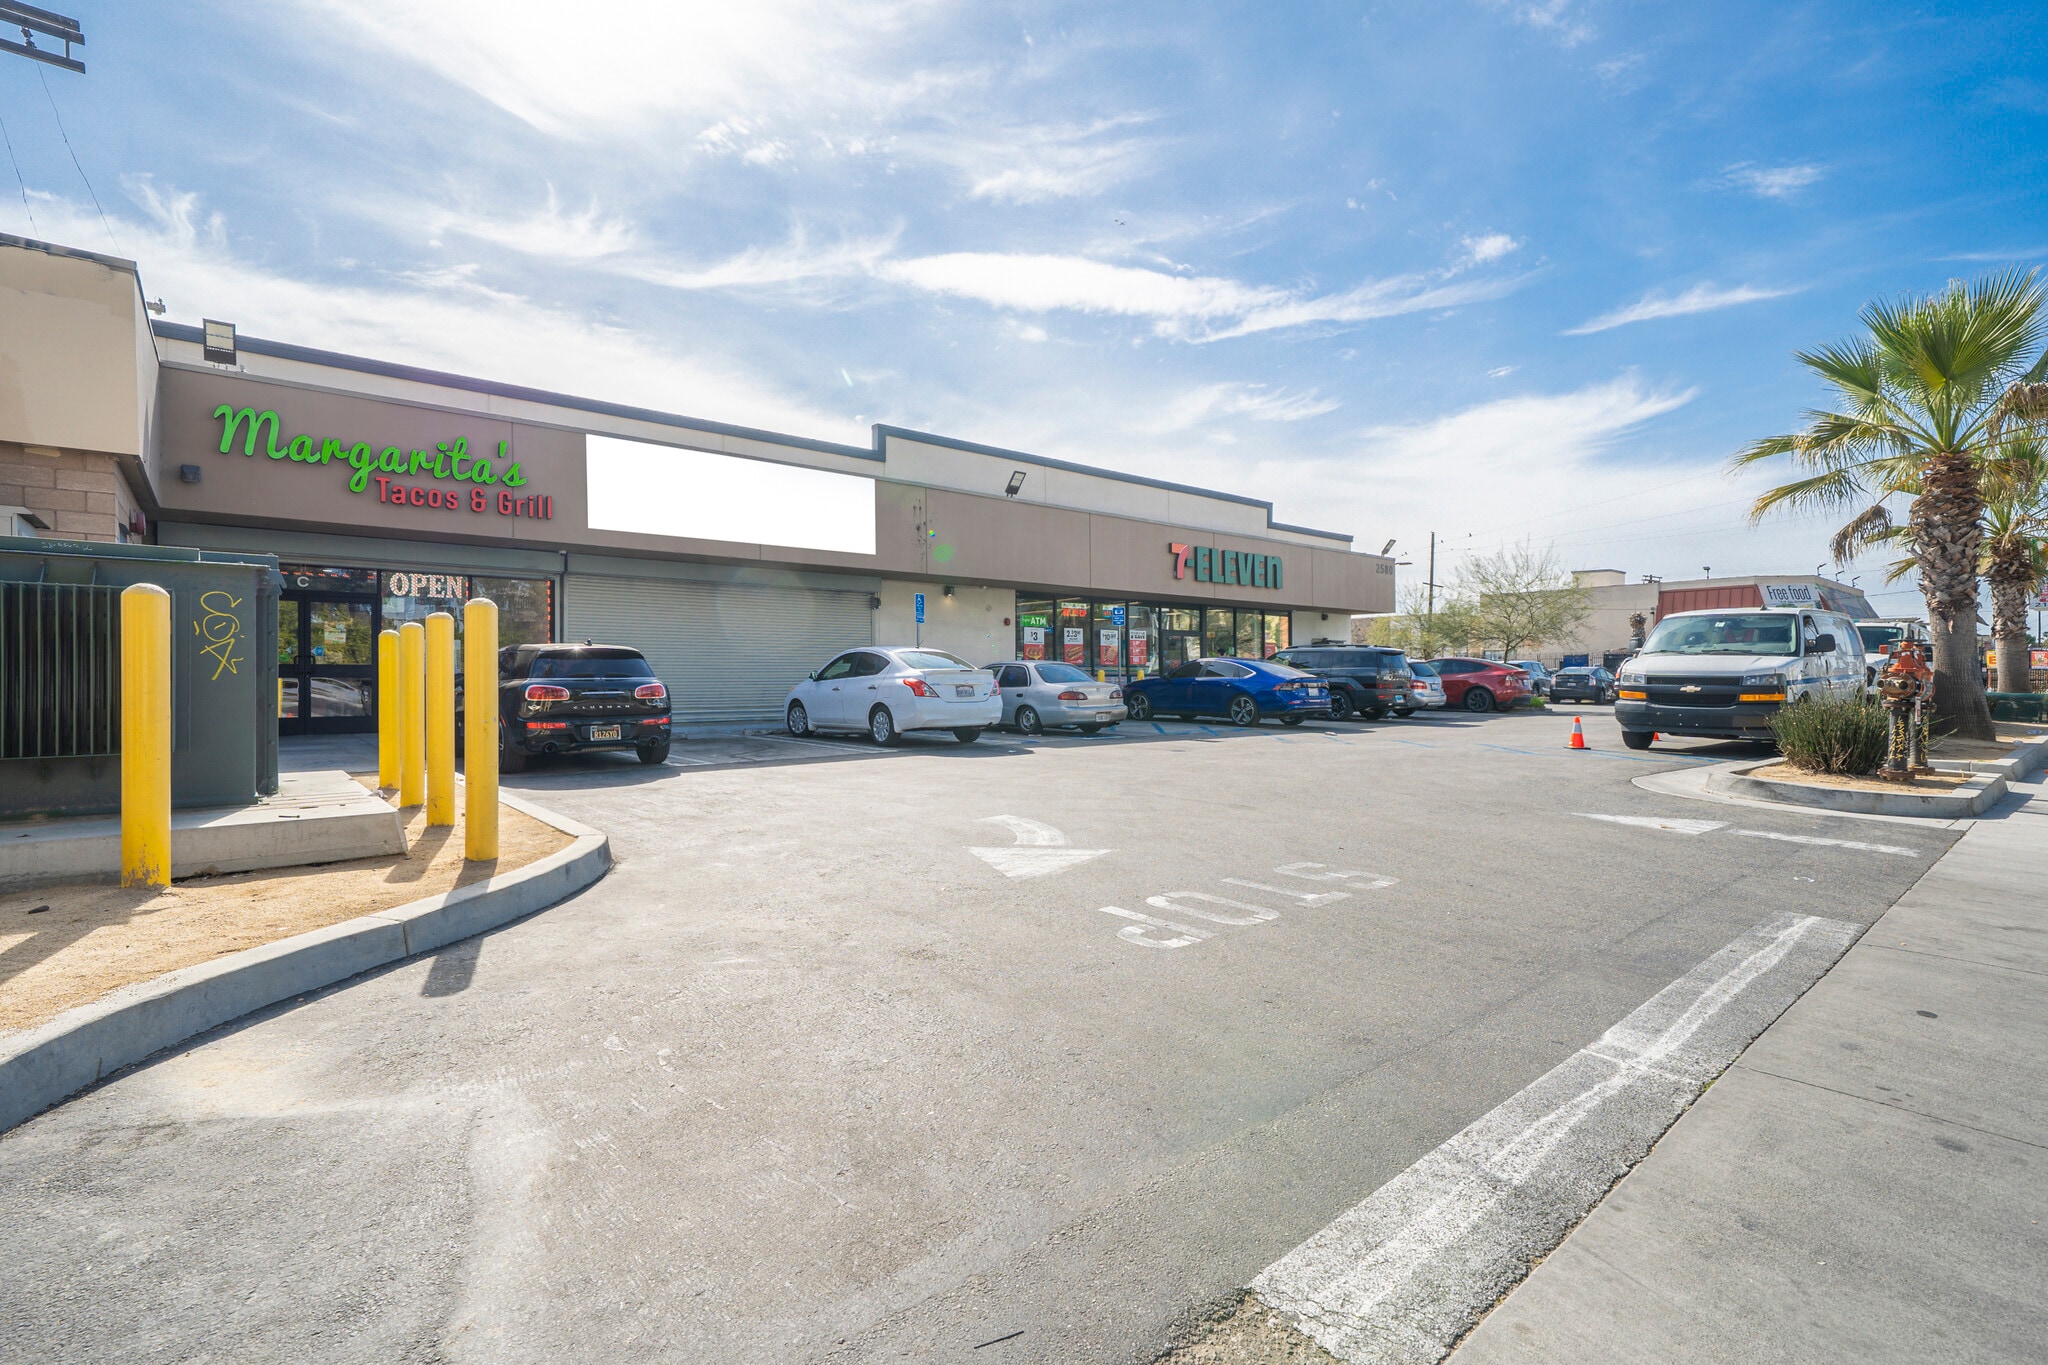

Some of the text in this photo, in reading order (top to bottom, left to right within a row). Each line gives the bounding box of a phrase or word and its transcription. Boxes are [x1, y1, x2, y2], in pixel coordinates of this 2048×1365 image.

[213, 404, 527, 493] Margarita's
[375, 476, 553, 520] Tacos & Grill
[1375, 563, 1394, 576] 2580
[389, 572, 463, 599] OPEN
[1766, 584, 1812, 601] Free food
[1030, 616, 1047, 625] ATM
[1098, 861, 1400, 950] STOP
